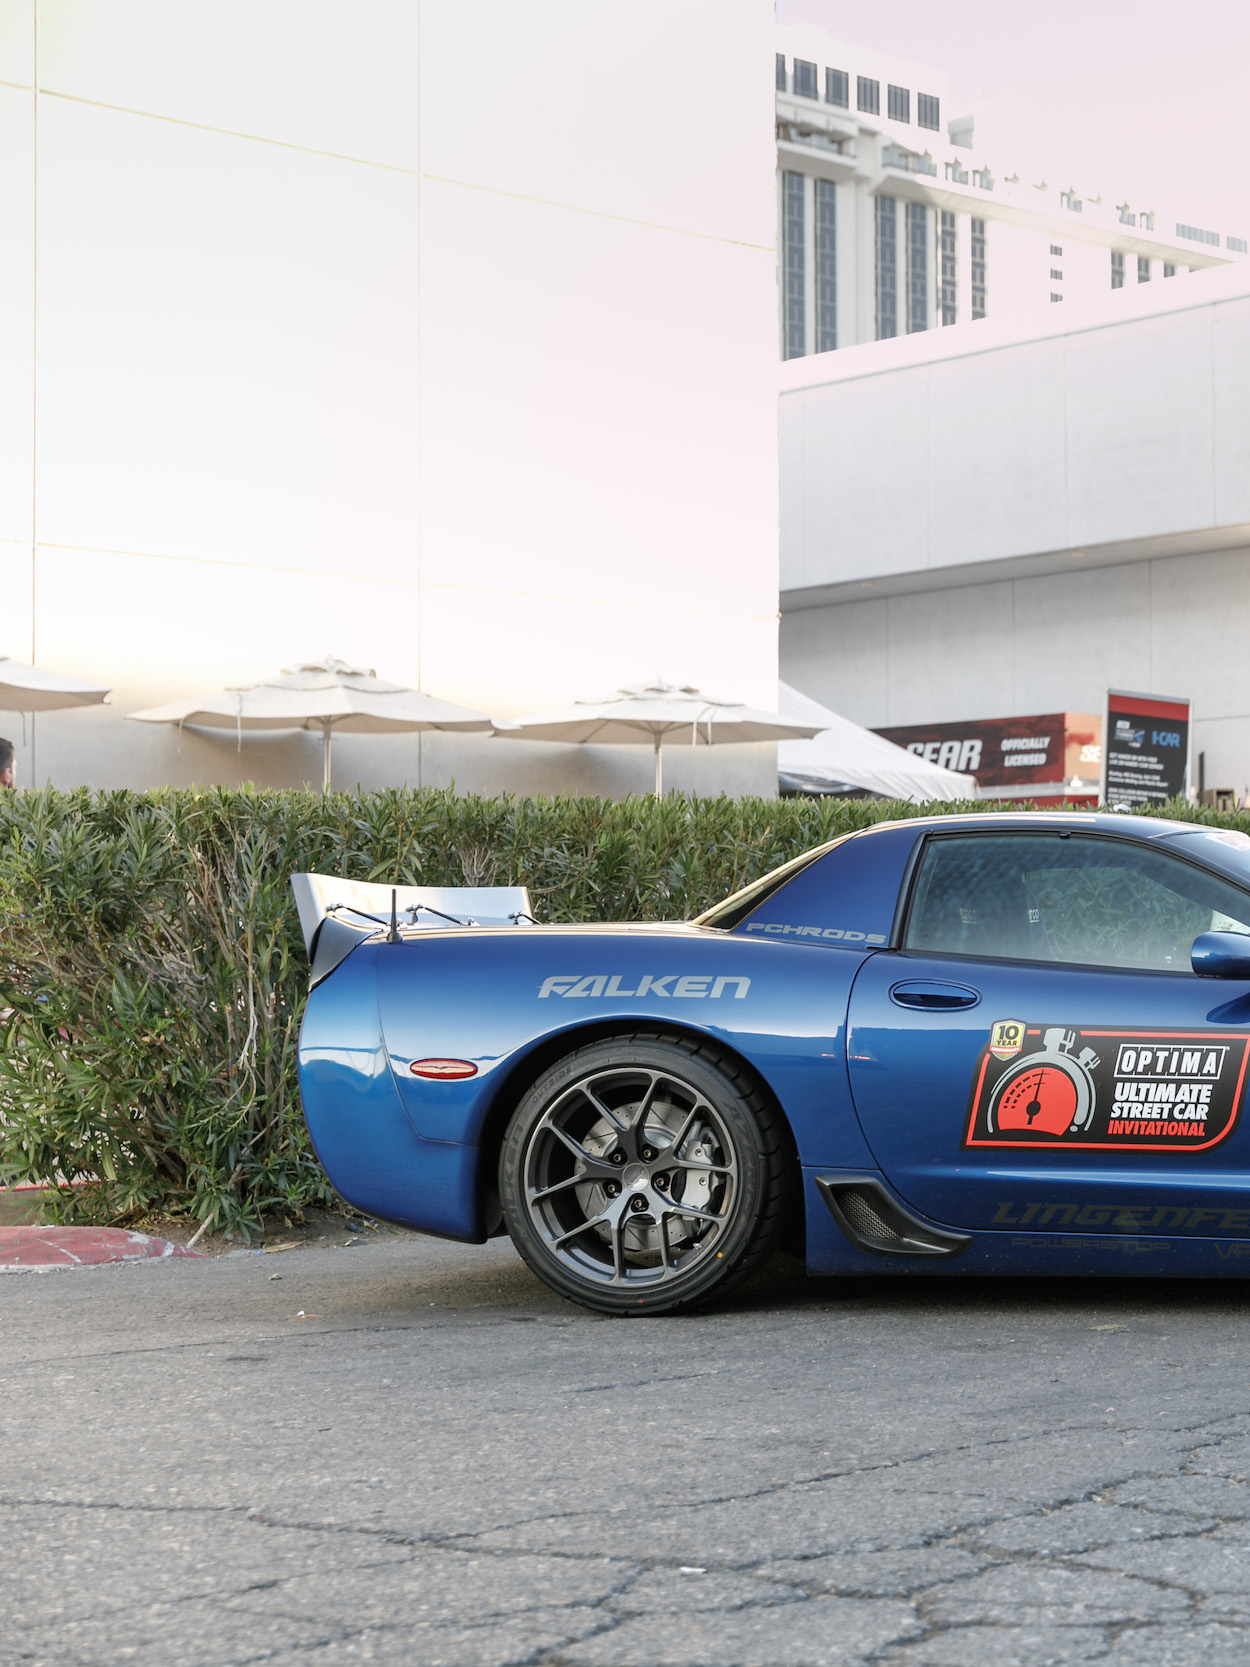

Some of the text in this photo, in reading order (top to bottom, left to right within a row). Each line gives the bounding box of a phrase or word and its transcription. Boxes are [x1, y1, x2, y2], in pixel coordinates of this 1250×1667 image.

[1000, 736, 1051, 752] OFFICIALLY
[1151, 731, 1180, 748] I-CAR
[1003, 753, 1047, 768] LICENSED
[746, 922, 887, 945] PCHRODS
[536, 974, 752, 1000] FALKEN
[998, 1025, 1020, 1040] 10
[996, 1039, 1018, 1047] YEAR
[1120, 1049, 1217, 1075] OPTIMA
[1113, 1082, 1213, 1104] ULTIMATE
[1110, 1103, 1209, 1121] STREET CAR
[1107, 1121, 1206, 1137] INVITATIONAL
[1011, 1237, 1172, 1252] POWERSTOP
